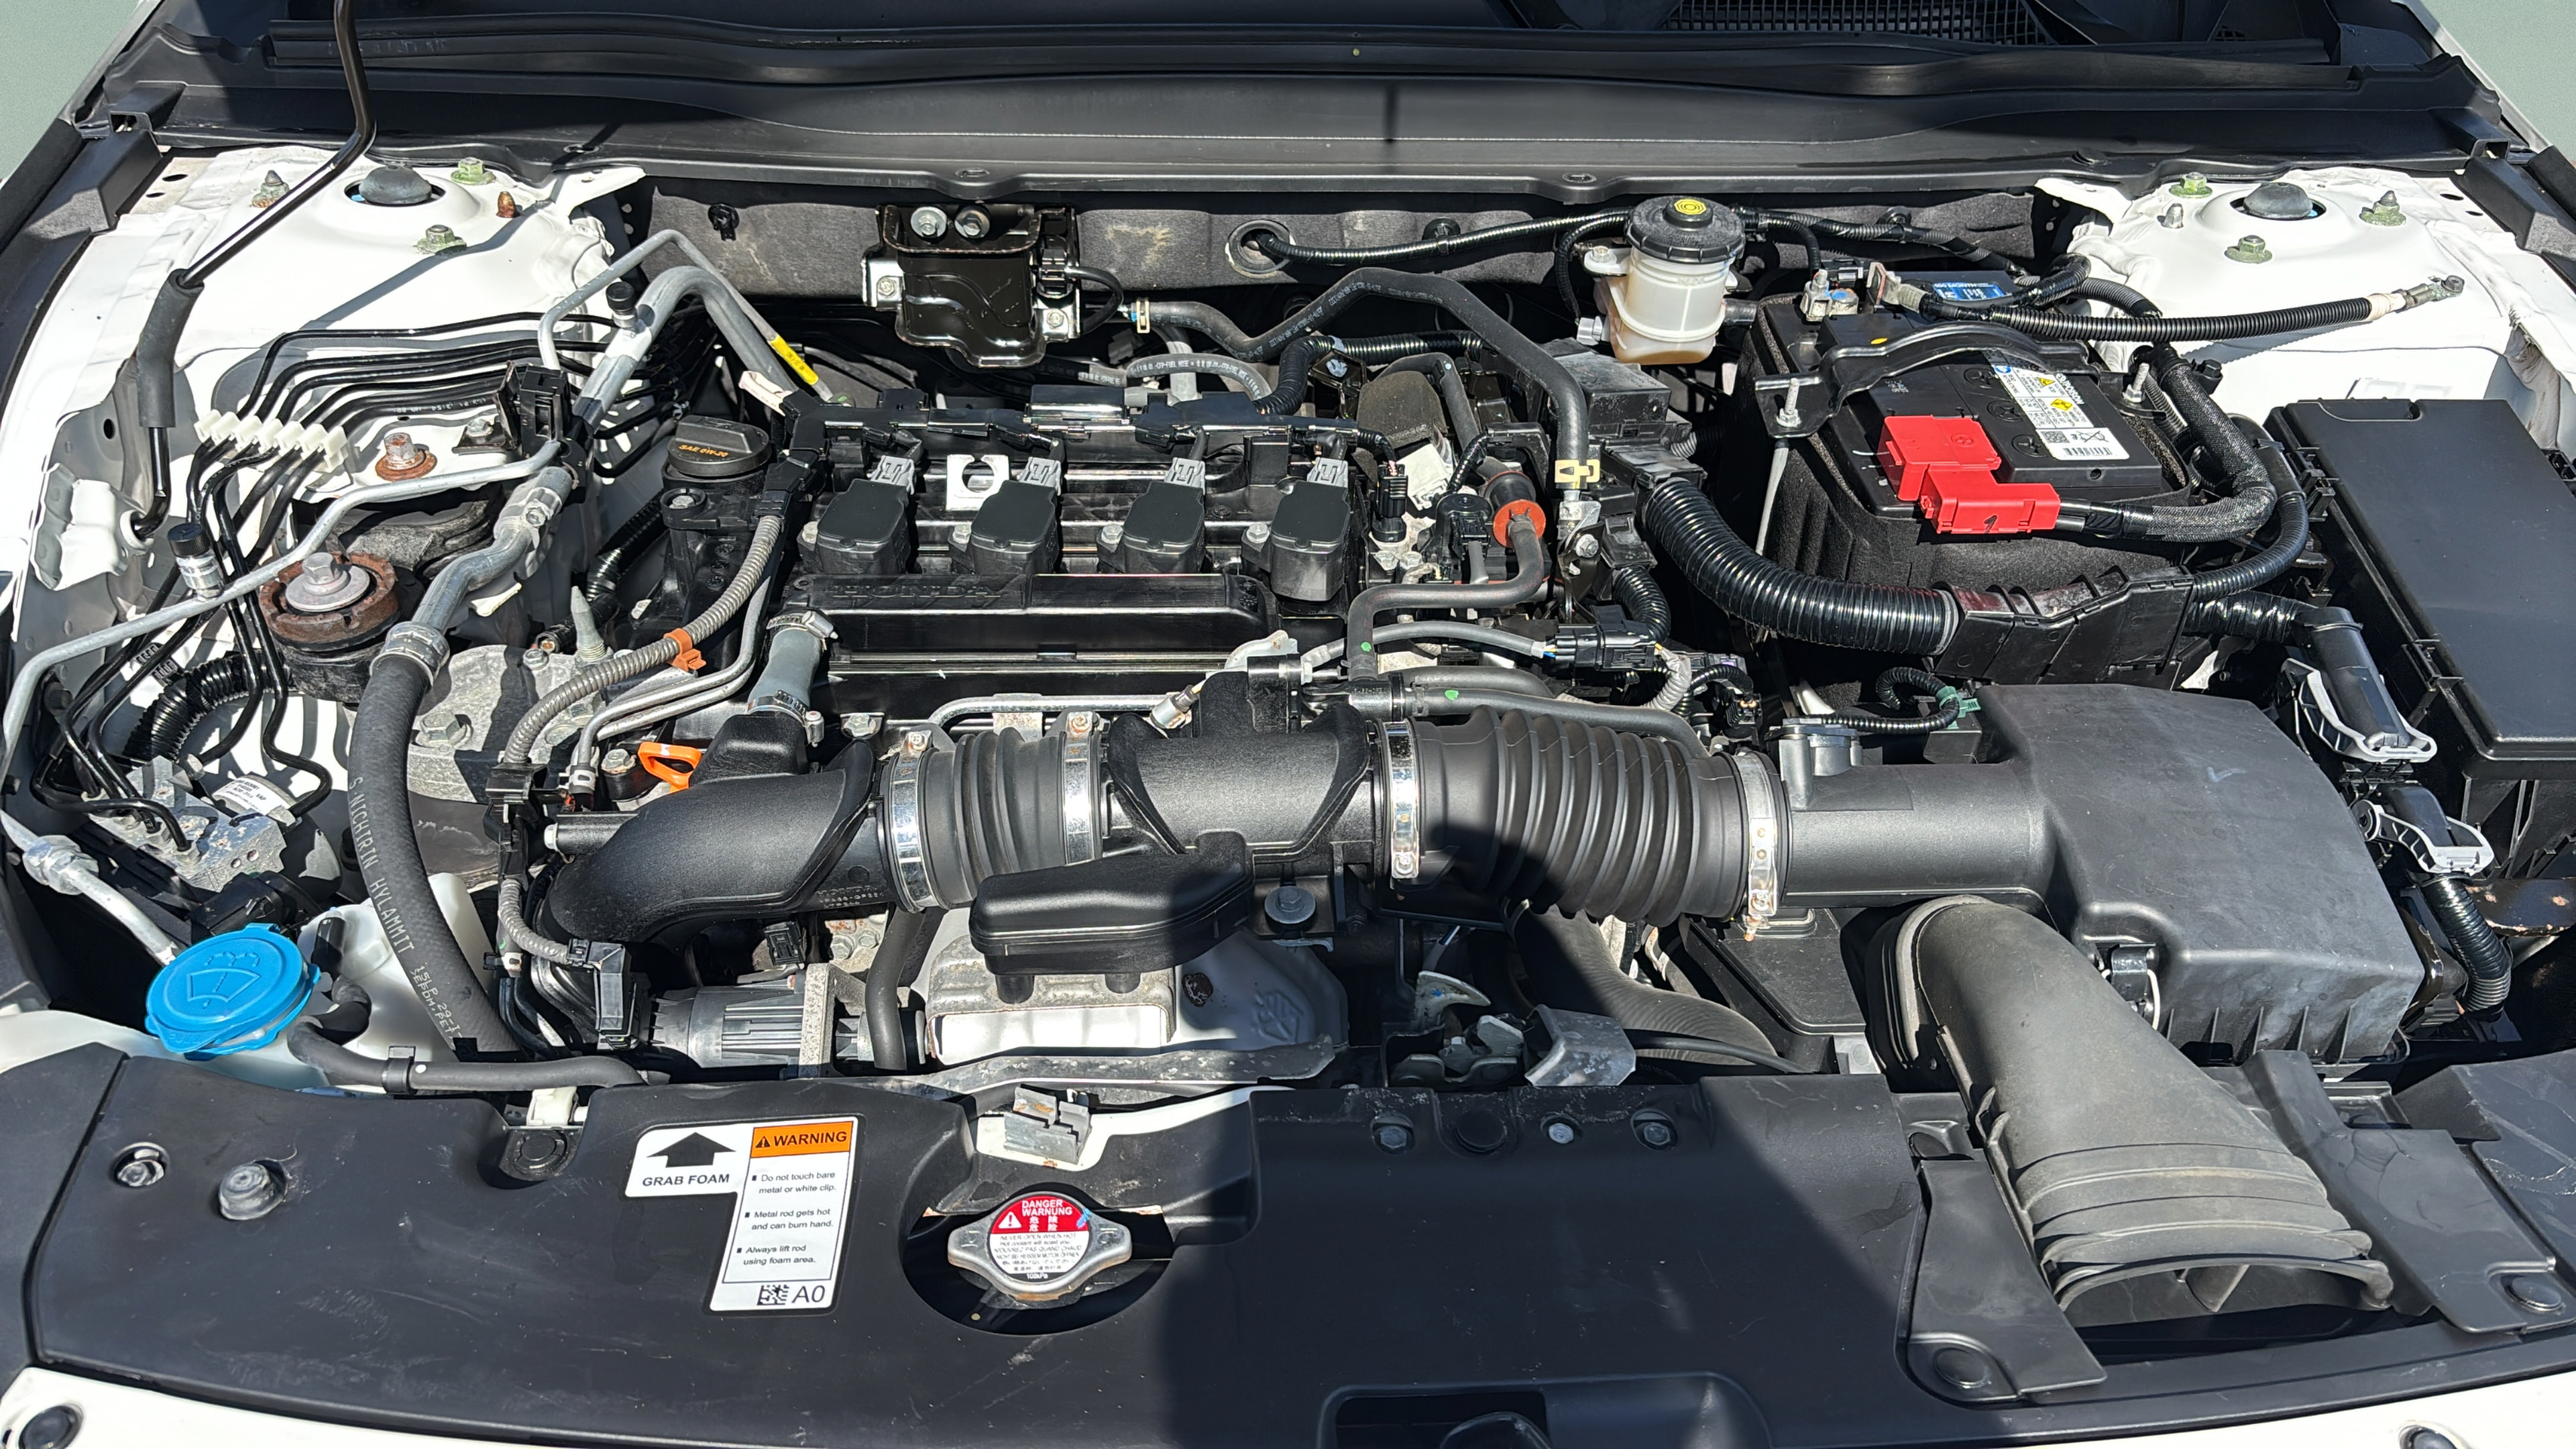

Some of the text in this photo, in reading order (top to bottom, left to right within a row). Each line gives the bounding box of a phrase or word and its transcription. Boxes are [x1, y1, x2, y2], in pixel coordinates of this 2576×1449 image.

[699, 448, 729, 458] 0W-20
[370, 877, 415, 954] HYLAMMIT
[773, 1131, 847, 1146] WARNING
[642, 1173, 730, 1187] GRAB FOAM
[791, 1173, 814, 1181] touch
[1021, 1199, 1063, 1209] DANGER
[796, 1210, 814, 1218] gets
[1021, 1207, 1072, 1217] WARNUNG
[743, 1258, 767, 1266] using
[791, 1285, 826, 1303] A0
